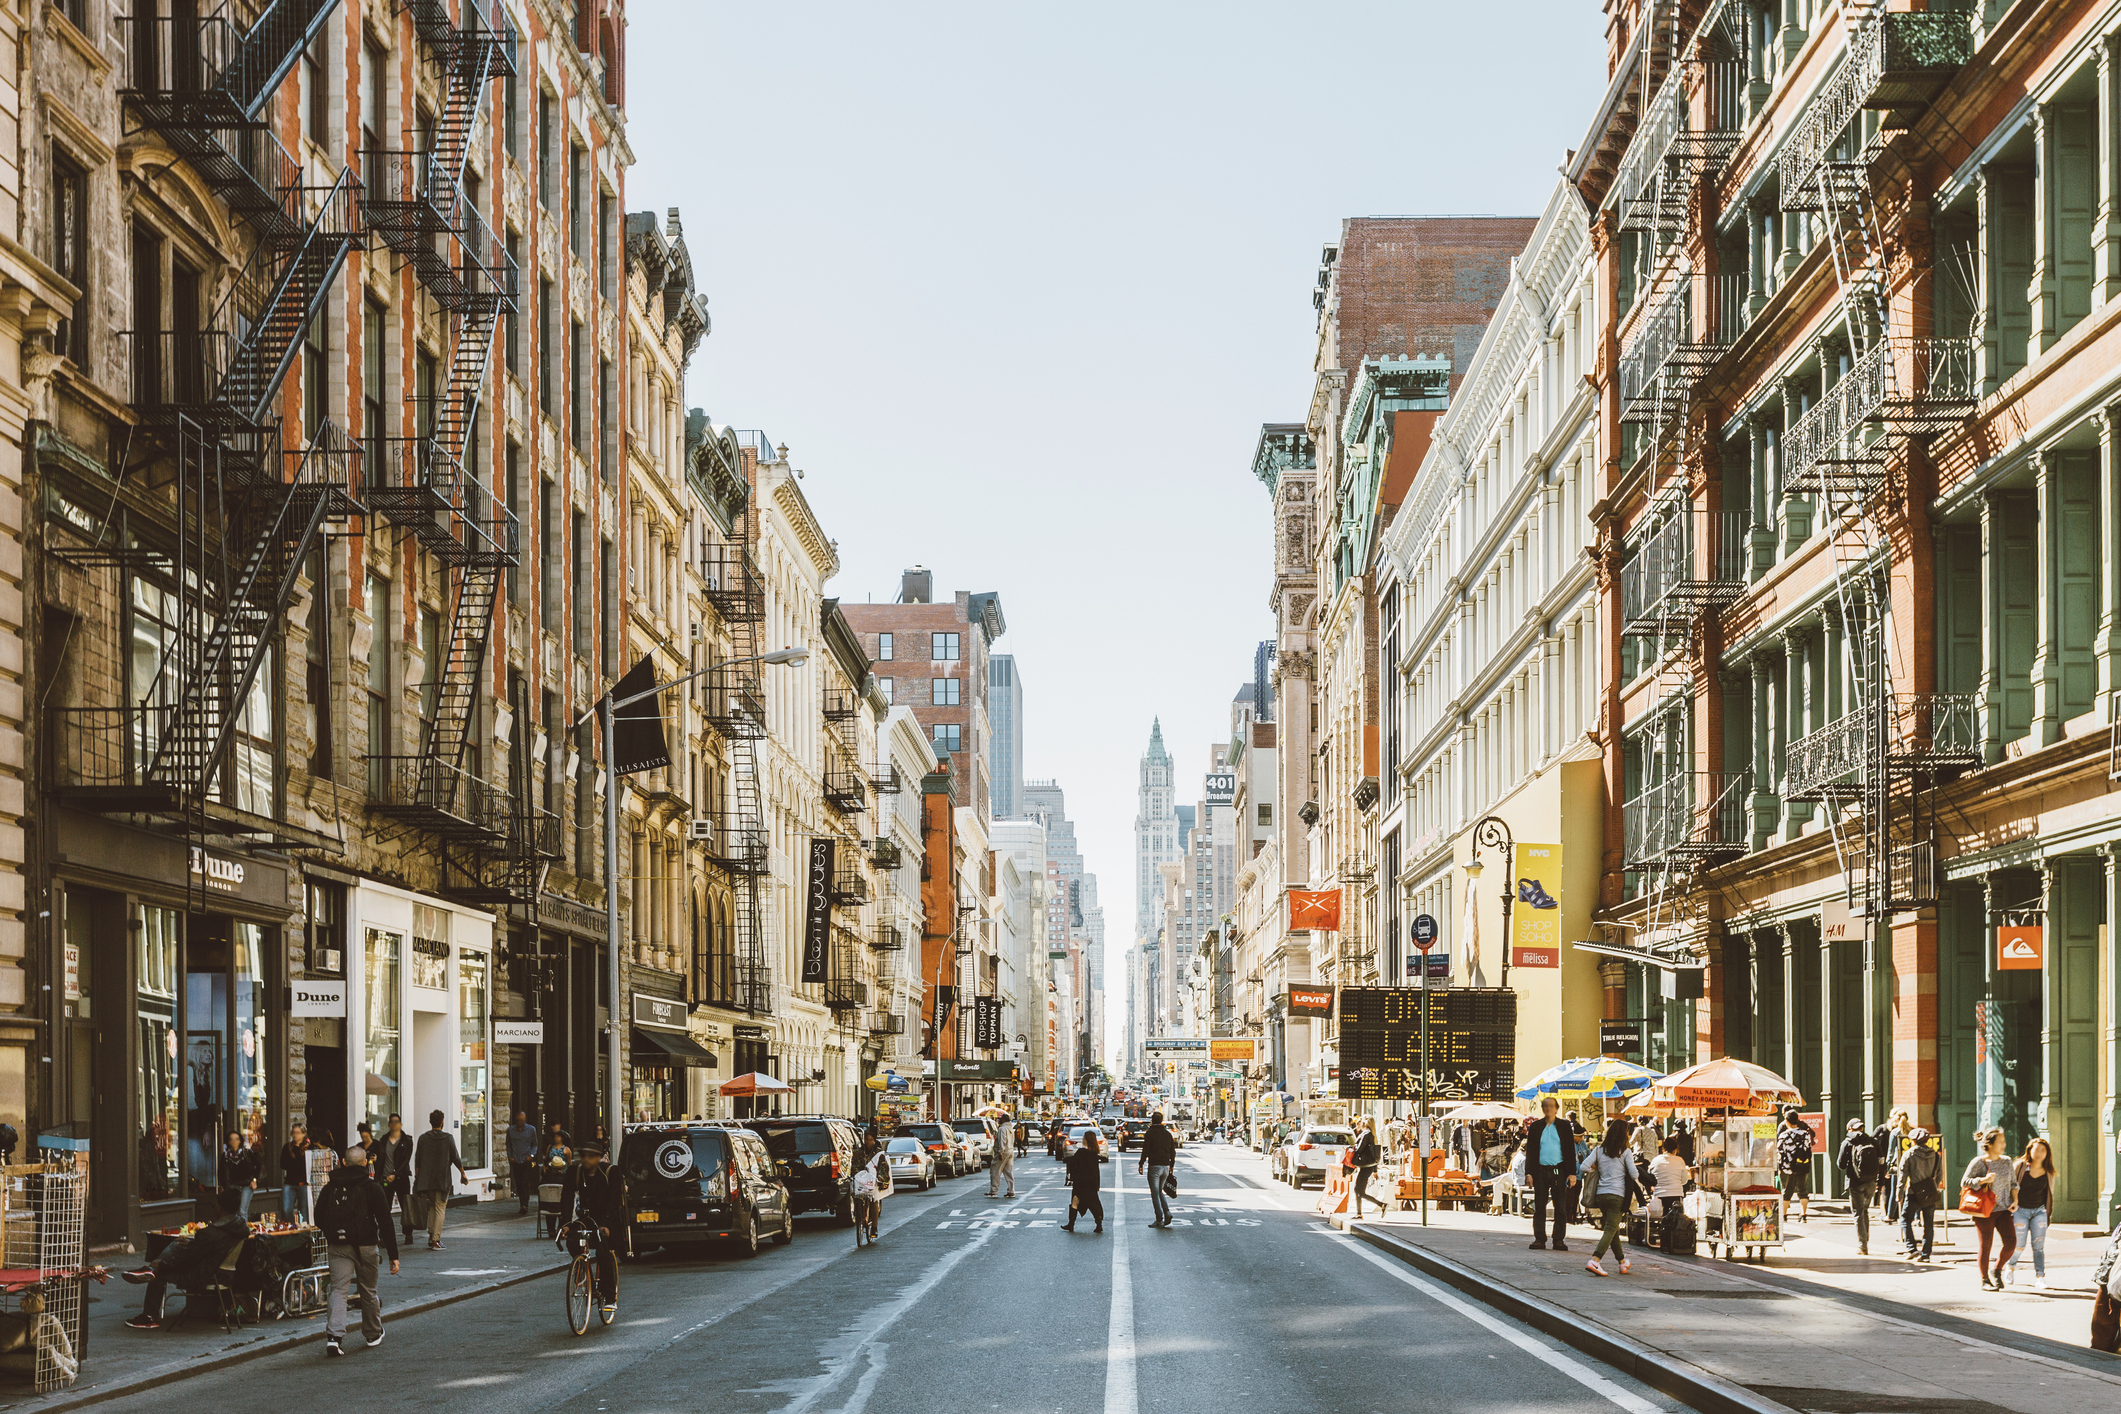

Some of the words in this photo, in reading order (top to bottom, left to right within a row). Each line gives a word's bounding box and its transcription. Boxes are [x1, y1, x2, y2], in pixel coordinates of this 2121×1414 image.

[1206, 776, 1233, 789] 401
[1206, 791, 1234, 802] Broadway
[1528, 848, 1550, 857] NYC
[190, 846, 244, 884] Dune
[1521, 920, 1552, 931] SHOP
[1826, 923, 1846, 938] H&M
[1520, 932, 1553, 943] SOHO
[413, 936, 451, 958] MARCIANO
[1407, 957, 1416, 965] M5
[1407, 967, 1416, 975] M5
[296, 992, 340, 1002] Dune
[1384, 992, 1448, 1024] ONE
[978, 1000, 987, 1043] TOPSHOP
[989, 1006, 997, 1045] TOPMAN
[1384, 1030, 1470, 1063] LANE
[1704, 1089, 1731, 1097] NATURAL
[1679, 1095, 1727, 1104] HONEY-ROASTED
[948, 1207, 1066, 1217] LANE
[935, 1220, 1058, 1230] FIRE
[1168, 1218, 1263, 1227] BUS
